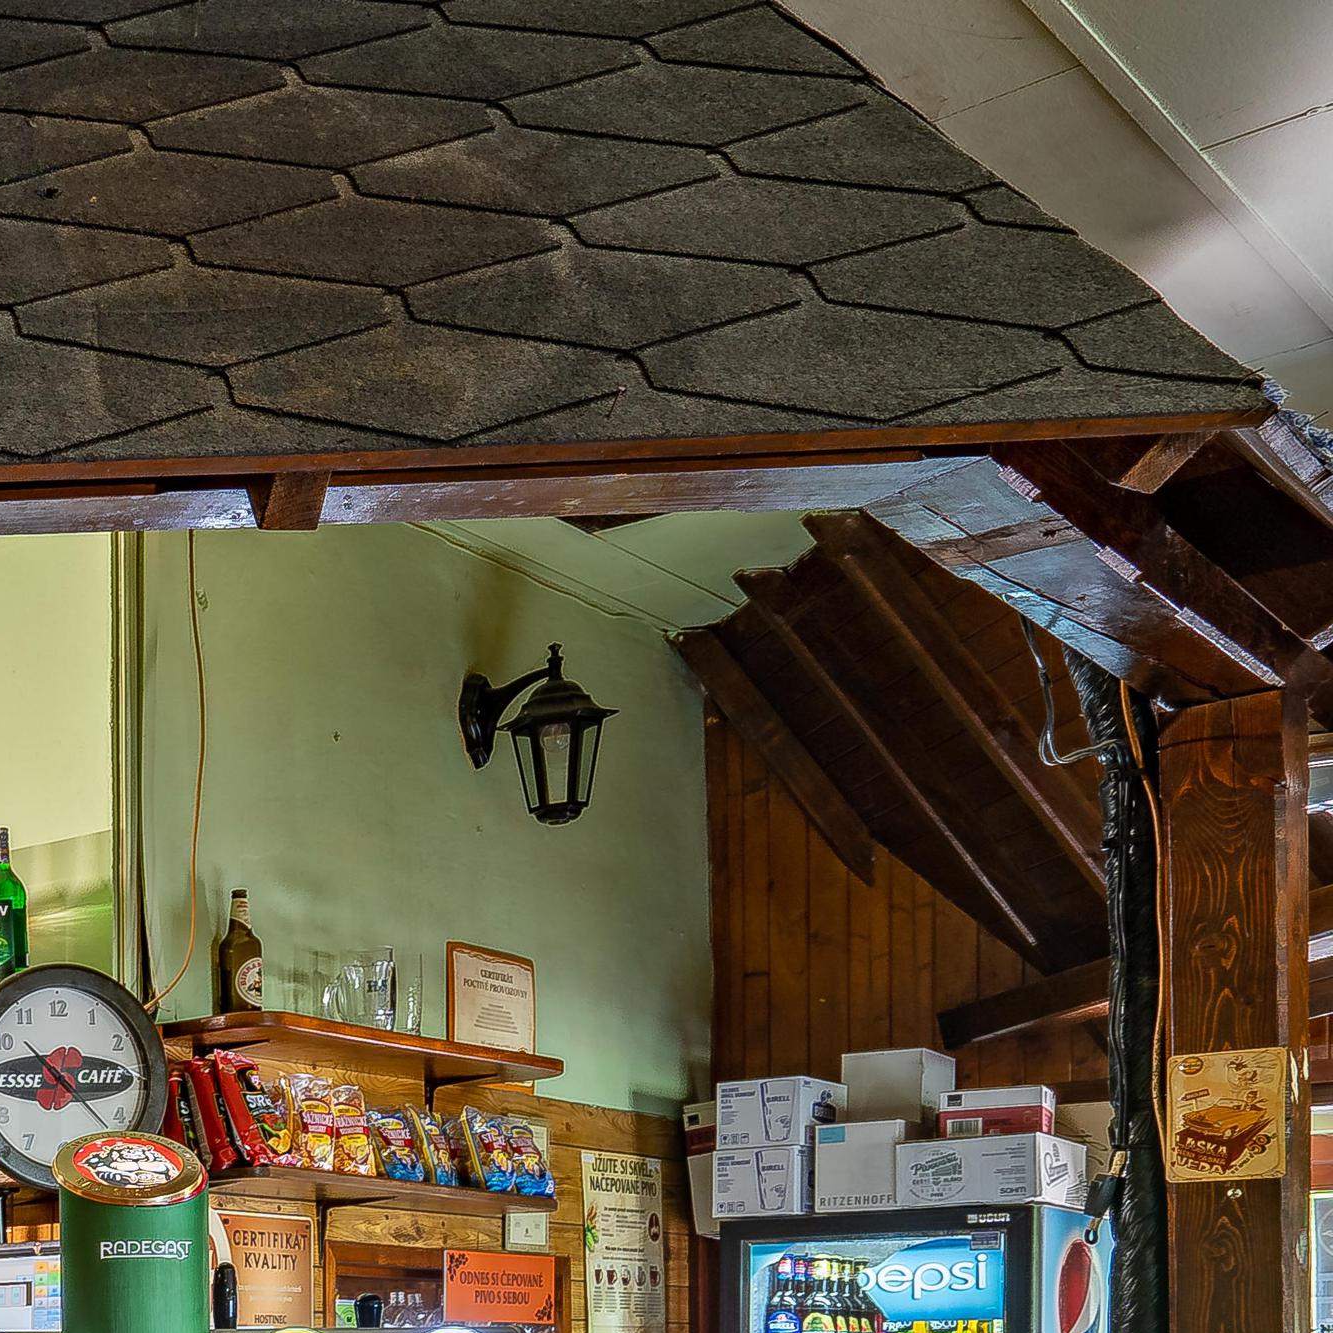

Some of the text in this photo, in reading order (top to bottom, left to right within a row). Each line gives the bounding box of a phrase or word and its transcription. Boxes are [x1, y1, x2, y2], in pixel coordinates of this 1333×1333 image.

[15, 1007, 33, 1025] 11
[48, 1000, 68, 1017] 12
[87, 1008, 96, 1026] 1
[111, 1034, 124, 1051] 2
[112, 1106, 126, 1124] 4
[22, 1133, 35, 1150] 7
[641, 1179, 658, 1197] PIVO
[820, 1194, 894, 1207] RITZENHOFF
[233, 1229, 308, 1251] CERTIFIKÁT
[100, 1240, 193, 1261] RADEGAST
[244, 1252, 298, 1271] KVALITY
[459, 1270, 544, 1288] ODNES SI ČEPOVANÉ
[474, 1290, 530, 1305] PIVO S SEBOU
[254, 1314, 287, 1325] HOSTINEC
